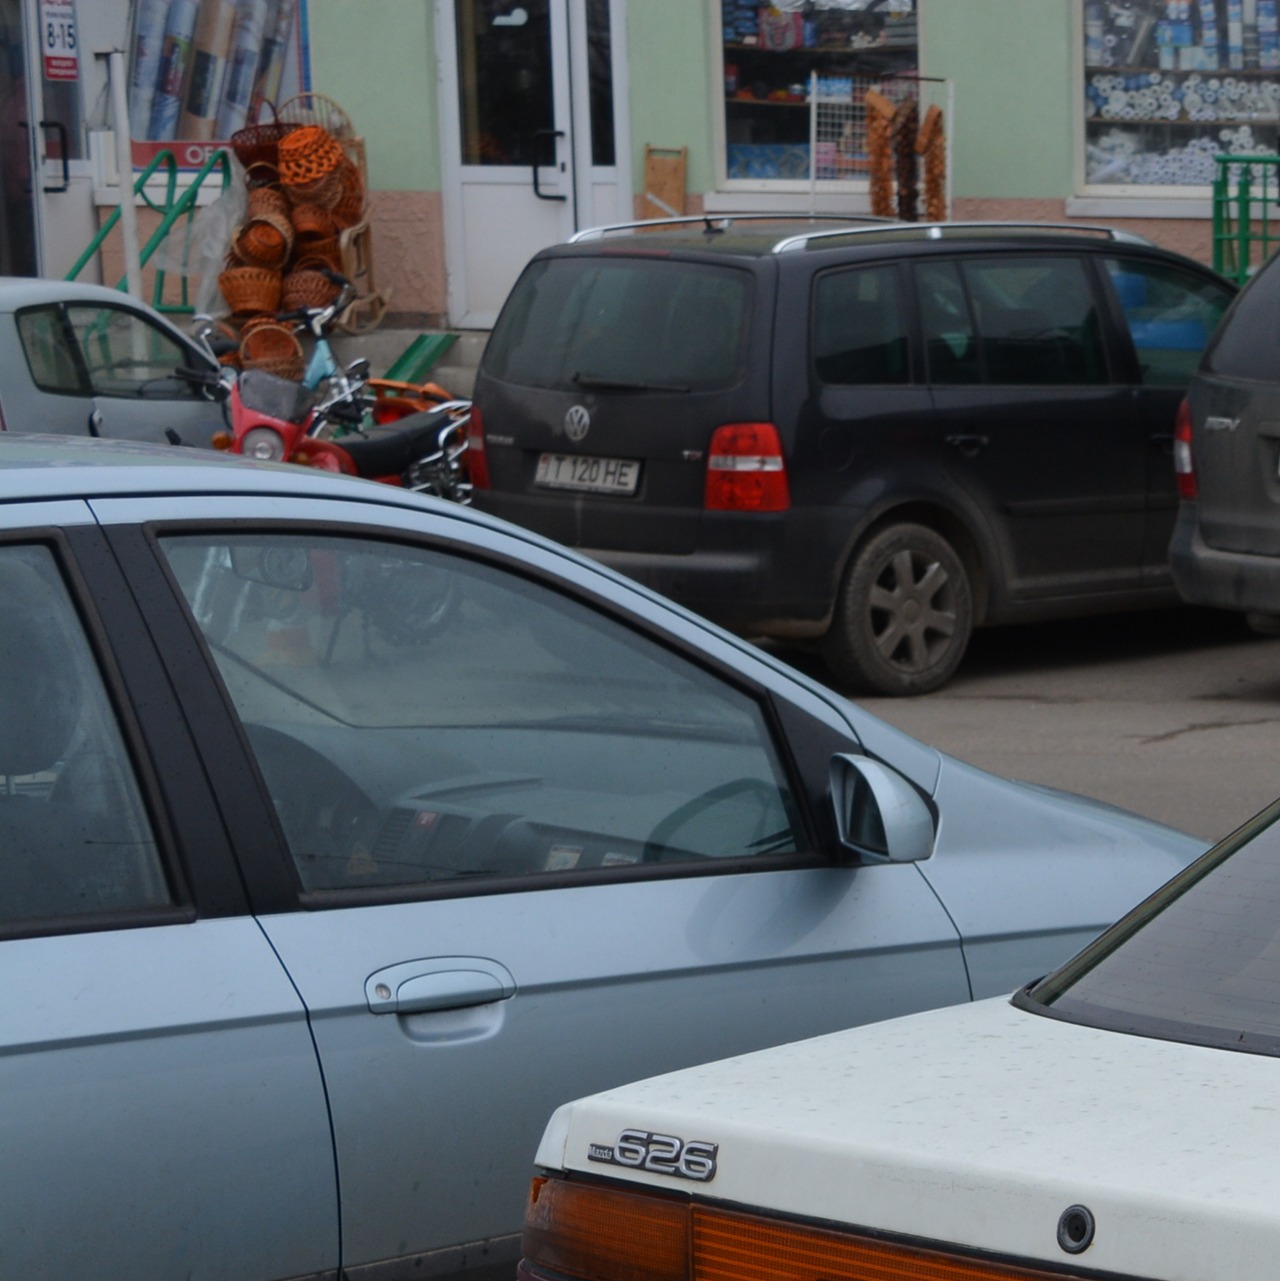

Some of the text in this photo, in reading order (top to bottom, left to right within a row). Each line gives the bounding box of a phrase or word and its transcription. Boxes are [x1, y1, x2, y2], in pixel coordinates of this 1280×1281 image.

[570, 457, 600, 483] 120
[602, 460, 633, 487] HE
[613, 1129, 718, 1183] 626
